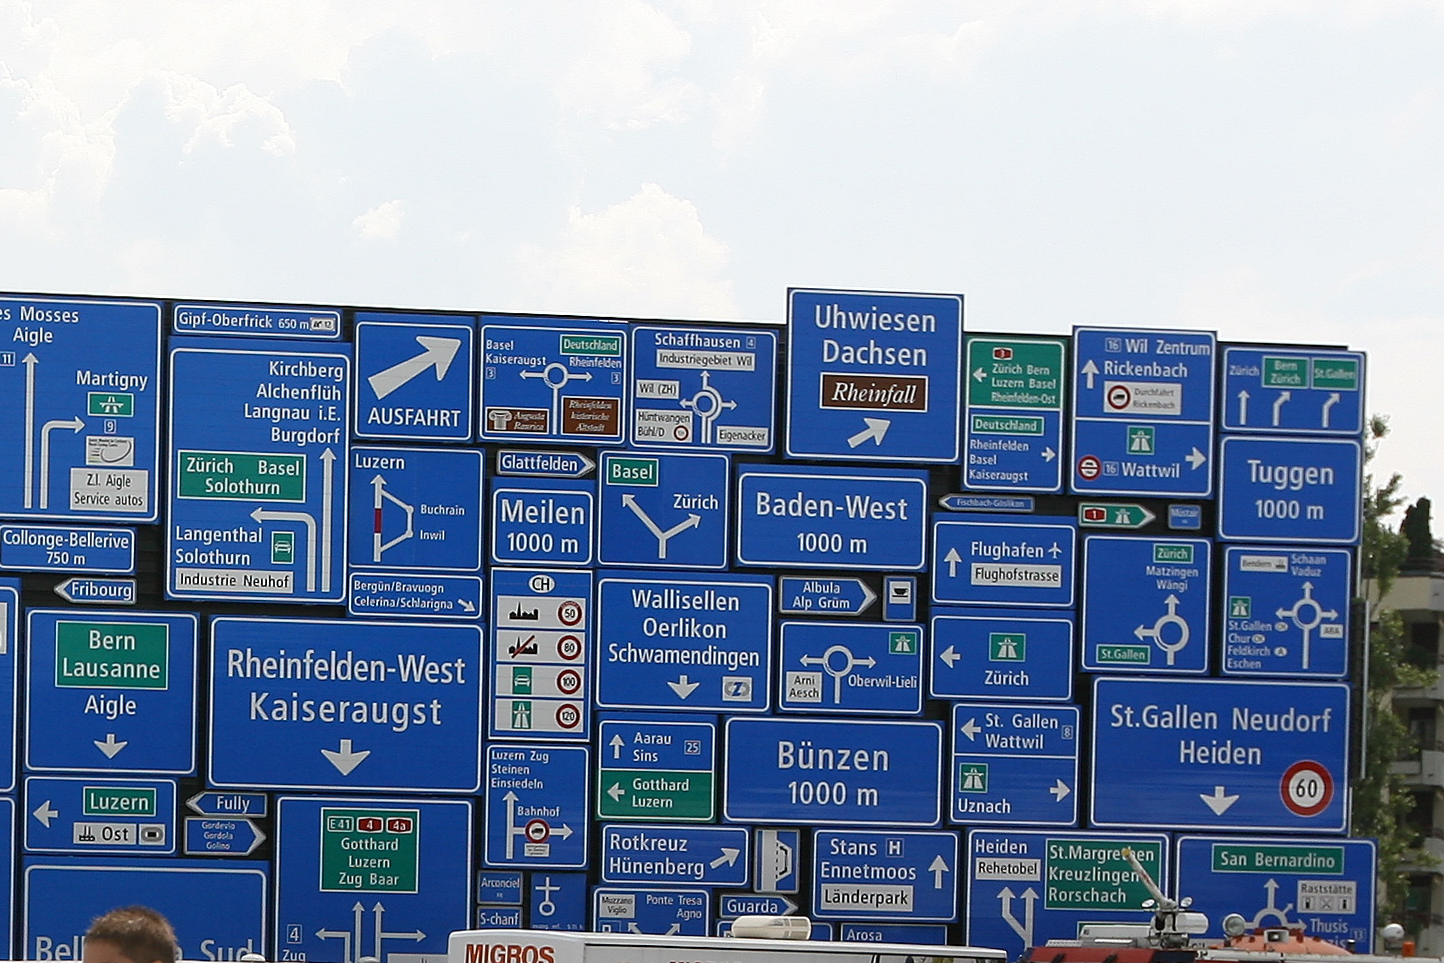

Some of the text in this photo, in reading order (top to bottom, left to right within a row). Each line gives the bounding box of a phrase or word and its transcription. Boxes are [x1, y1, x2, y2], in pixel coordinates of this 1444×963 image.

[21, 306, 78, 322] Mosses
[816, 304, 935, 332] Uhwiesen
[13, 327, 52, 346] Aigle
[655, 333, 740, 348] Schaffhausen
[824, 340, 926, 366] Dachsen
[1125, 339, 1210, 355] Wil Zentrum
[270, 361, 343, 382] Kirchberg
[1105, 361, 1187, 377] Rickenbach
[77, 370, 147, 391] Martigny
[257, 383, 340, 400] Alchenflüh
[832, 383, 916, 406] Rheinfall
[245, 403, 340, 422] Langnau i.E.
[368, 408, 461, 427] AUSFAHRT
[272, 427, 340, 446] Burgdorf
[720, 430, 765, 442] Eigenacker
[187, 457, 299, 475] Zürich Basel
[502, 455, 577, 471] Glattfelden
[1122, 462, 1179, 478] Wattwil
[1247, 460, 1333, 490] Tuggen
[206, 478, 279, 494] Solothurn
[75, 492, 142, 506] Service autos
[674, 494, 718, 509] Zürich
[757, 492, 907, 520] Baden-West
[421, 504, 464, 515] Buchrain
[502, 499, 584, 524] Meilen
[3, 530, 128, 550] Collonge-Bellerive
[176, 526, 262, 545] Langenthal
[972, 541, 1043, 560] Flughafen
[976, 567, 1058, 583] Flughofstrasse
[1146, 566, 1198, 582] Matzingen
[355, 580, 443, 595] Bergün/Bravuogn
[532, 577, 549, 590] CH
[803, 582, 840, 593] Albula
[354, 596, 452, 611] Celerina/Schlarigna
[632, 589, 738, 611] Wallisellen
[644, 618, 726, 638] Oerlikon
[228, 648, 465, 683] Rheinfelden-West
[609, 643, 759, 670] Schwamendingen
[848, 674, 917, 688] Oberwil-Lieli
[85, 694, 136, 719] Aigle
[251, 692, 441, 732] Kaiseraugst
[986, 713, 1058, 729] St. Gallen
[1111, 704, 1332, 732] St.Gallen Neudorf
[779, 741, 888, 770] Bünzen
[1180, 740, 1260, 765] Heiden
[1296, 779, 1317, 797] 60
[91, 793, 148, 810] Luzern
[216, 796, 250, 813] Fully
[959, 798, 1010, 813] Uznach
[102, 827, 128, 841] Ost
[611, 833, 687, 851] Rotkreuz
[1050, 845, 1154, 863] St.Margreen
[1221, 851, 1335, 868] San Bernardino
[610, 857, 703, 880] Hünenberg
[821, 862, 916, 880] Ennetmoos
[1049, 867, 1139, 886] Kreuzlingen
[825, 889, 908, 908] Länderpark
[1049, 887, 1126, 903] Rorschach
[676, 908, 702, 921] Agno
[727, 899, 777, 913] Guarda
[480, 911, 519, 927] S-chanf
[1310, 918, 1348, 933] Thusis
[847, 929, 882, 941] Arosa
